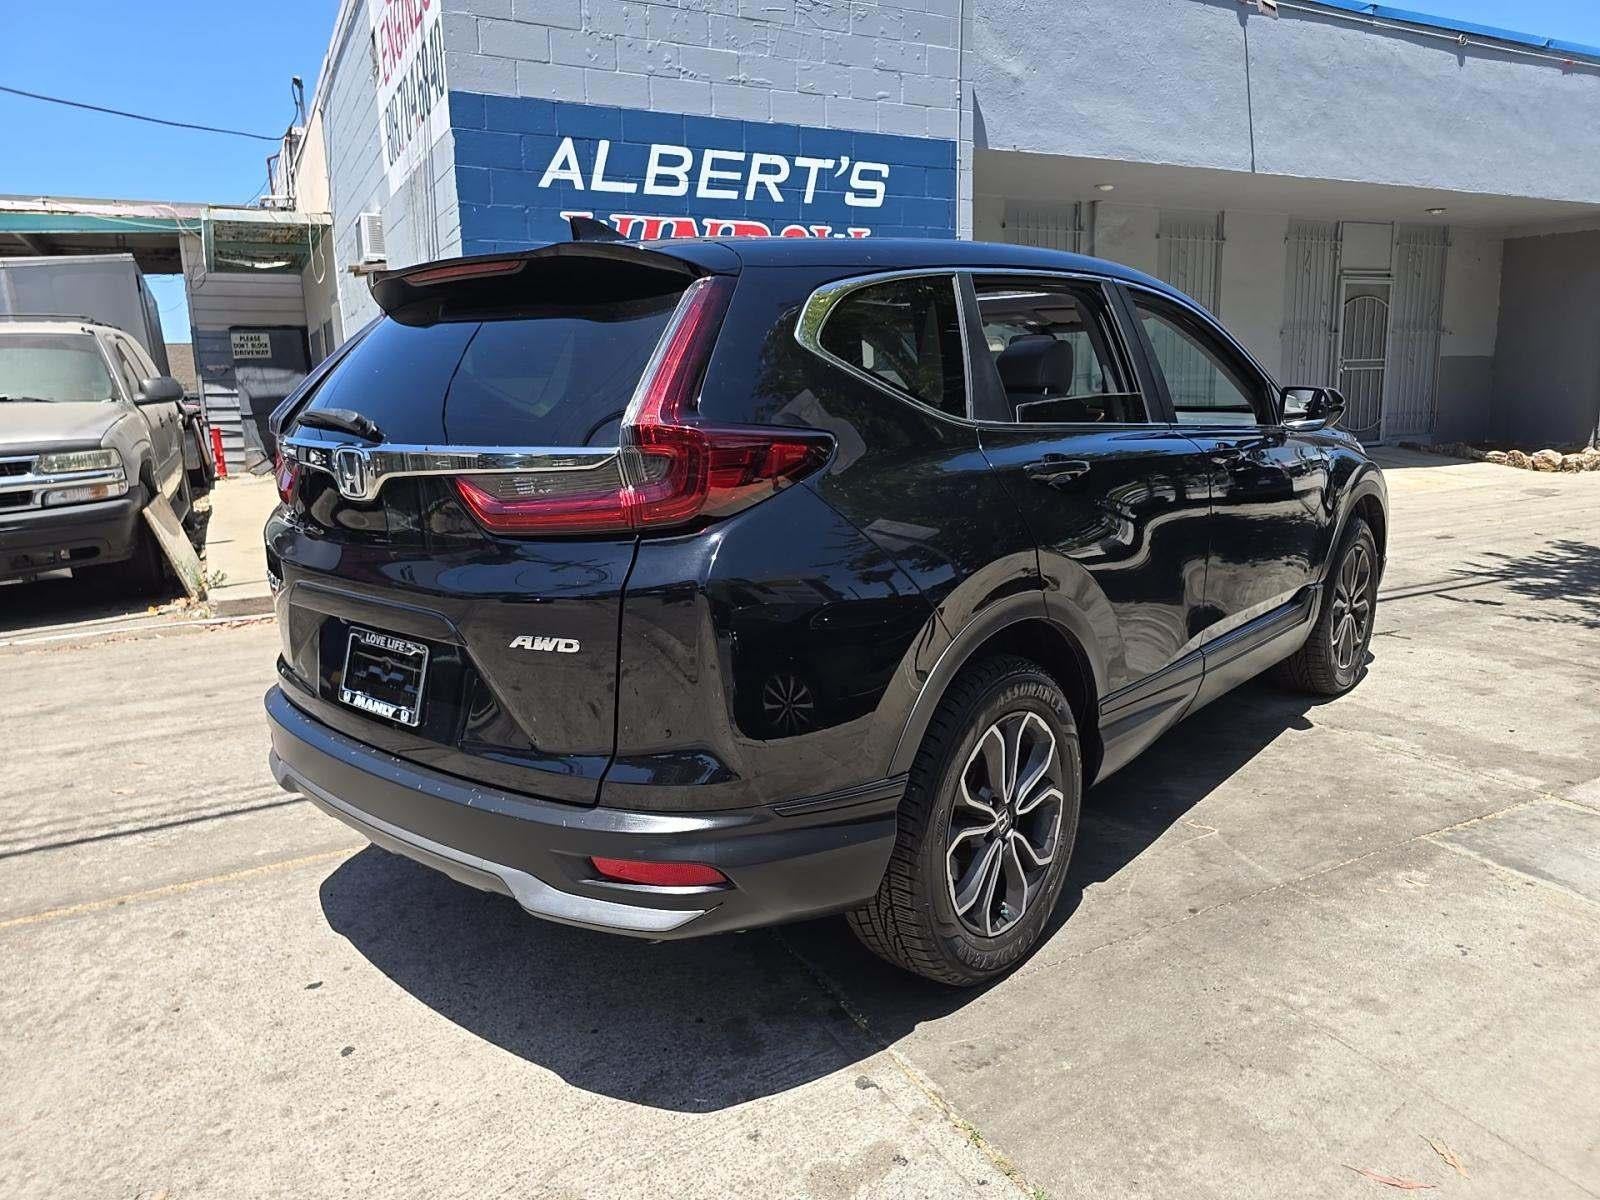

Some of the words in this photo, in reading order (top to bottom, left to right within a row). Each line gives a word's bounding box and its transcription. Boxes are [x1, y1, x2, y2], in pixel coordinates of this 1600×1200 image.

[538, 136, 890, 208] ALBERT'S
[366, 633, 386, 647] LOVE
[387, 638, 405, 651] LIFE
[508, 635, 581, 653] AWD
[353, 694, 396, 718] MANLY
